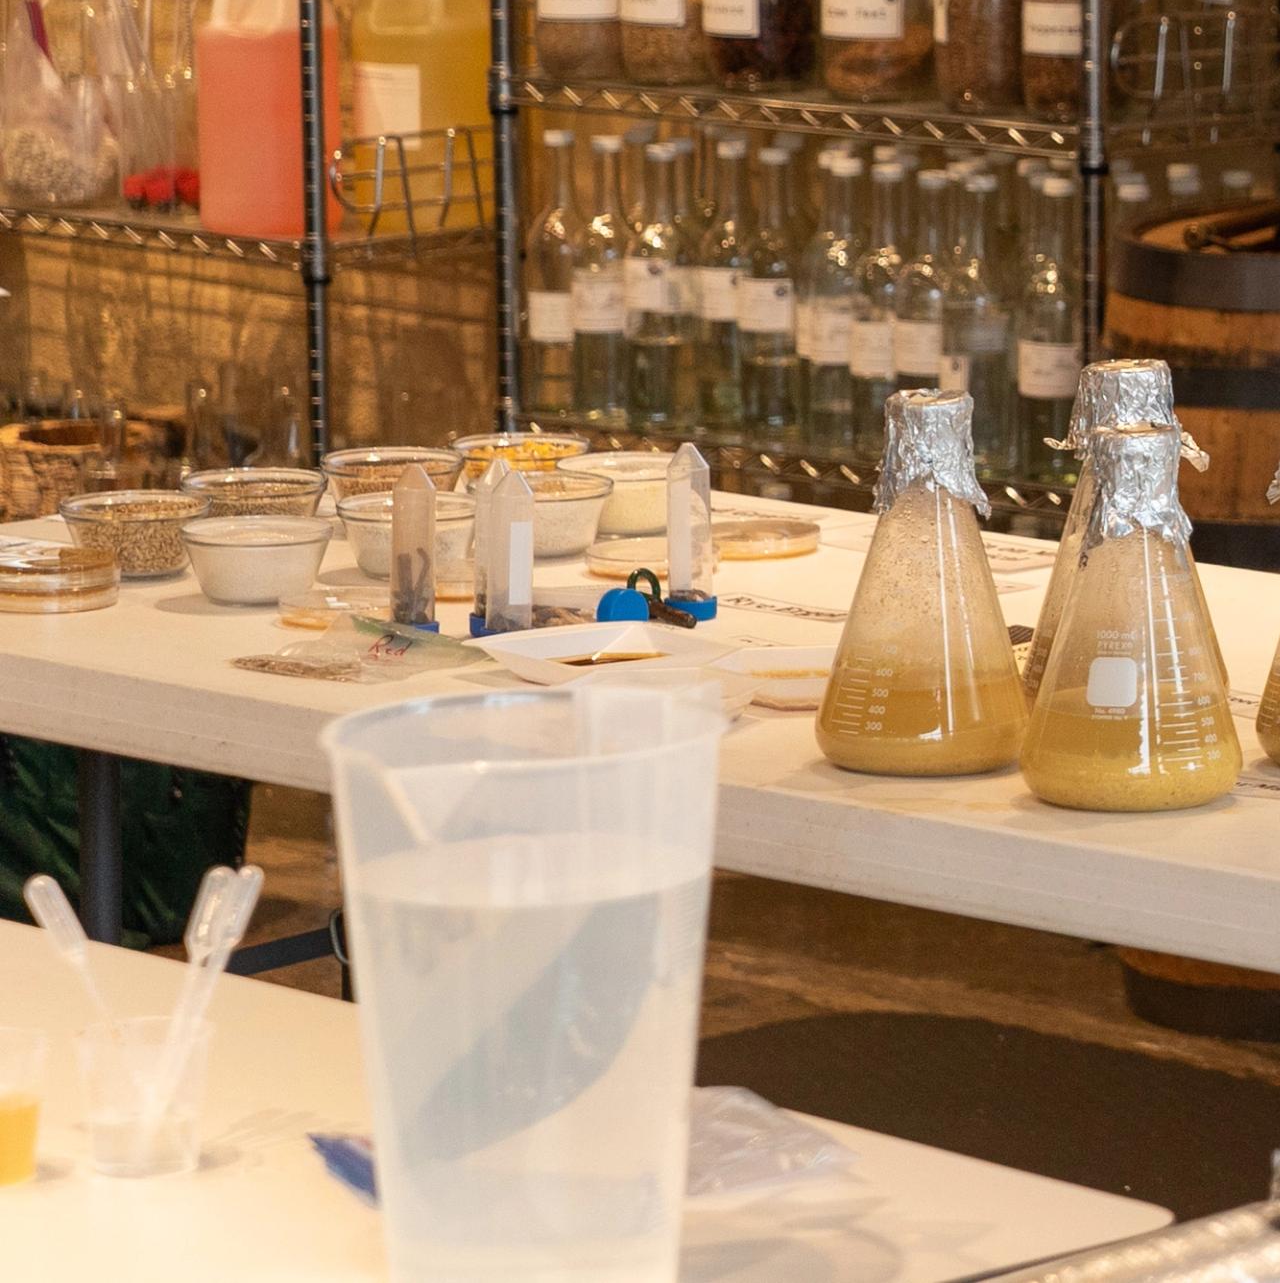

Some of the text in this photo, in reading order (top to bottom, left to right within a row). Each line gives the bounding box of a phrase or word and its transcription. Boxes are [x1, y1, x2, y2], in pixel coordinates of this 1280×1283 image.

[368, 634, 414, 657] Red
[871, 688, 889, 698] 500
[868, 705, 886, 715] 400
[864, 721, 882, 731] 300
